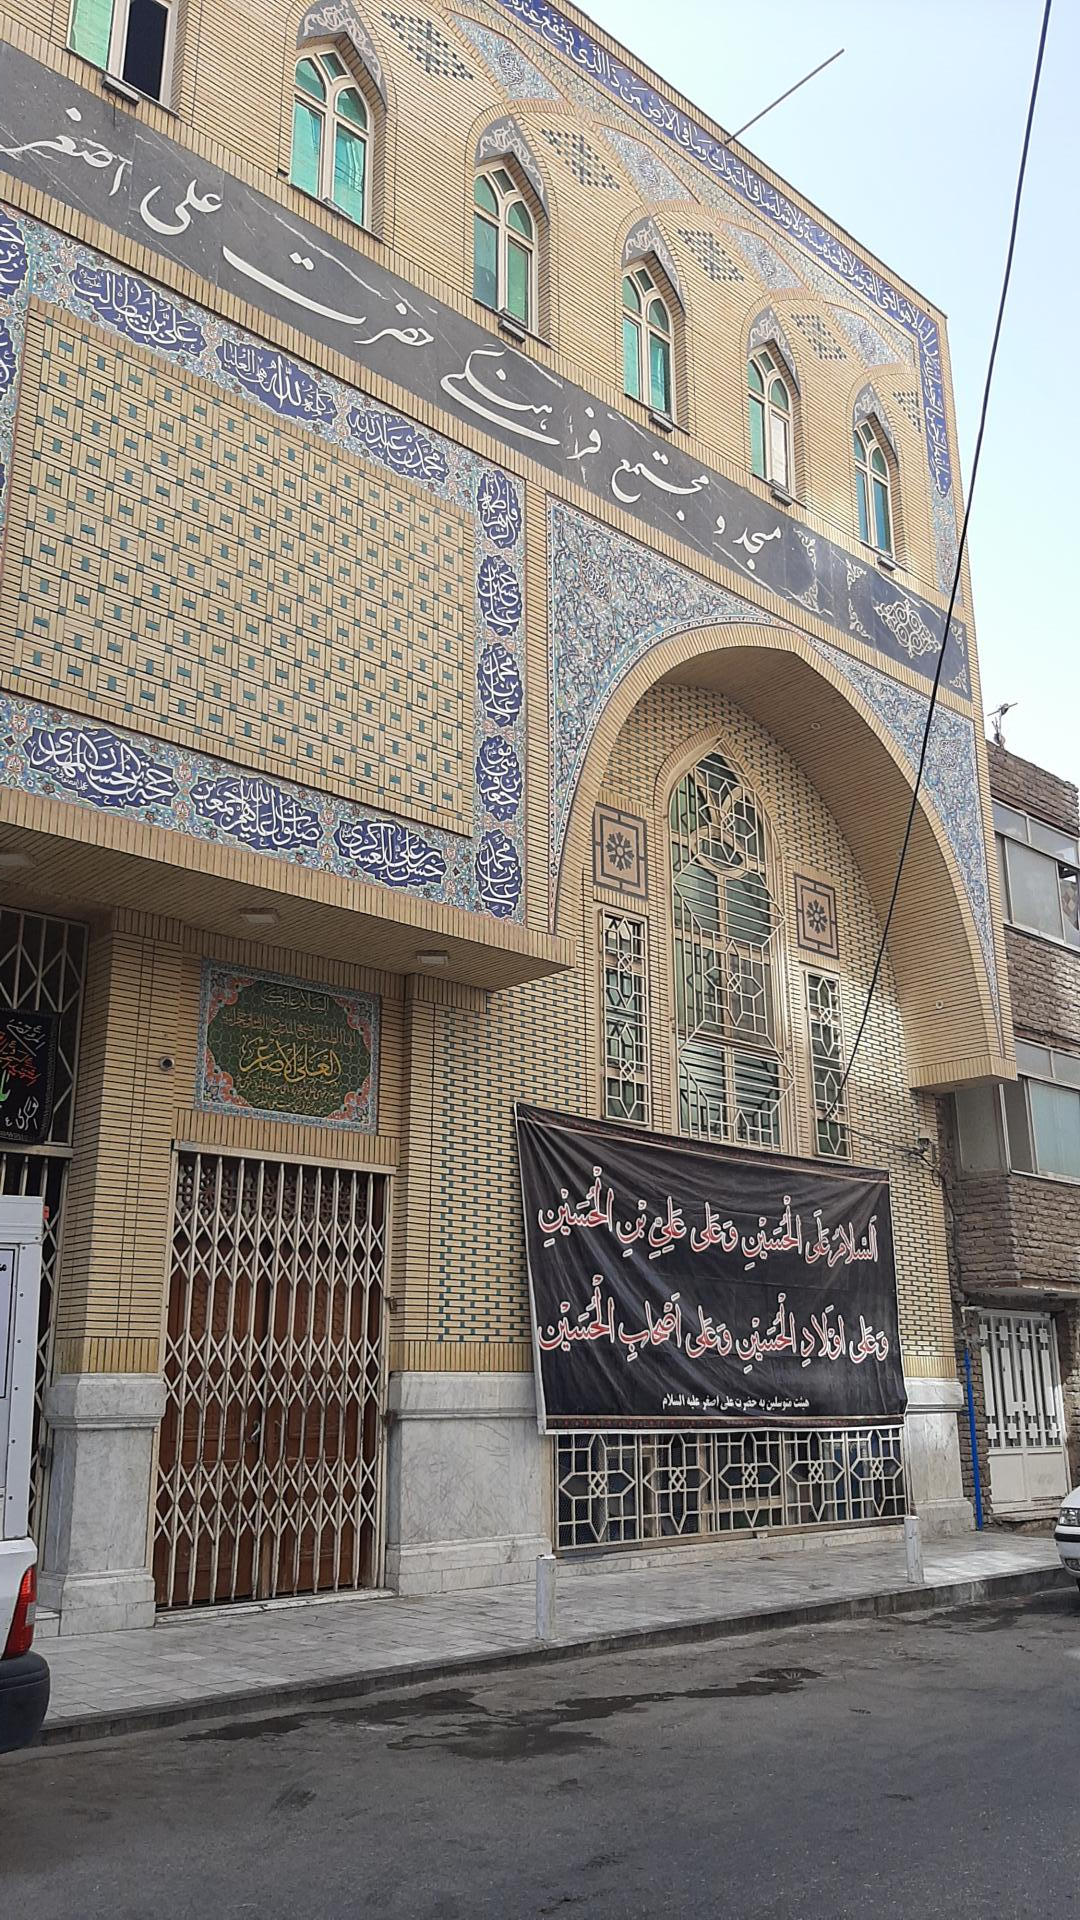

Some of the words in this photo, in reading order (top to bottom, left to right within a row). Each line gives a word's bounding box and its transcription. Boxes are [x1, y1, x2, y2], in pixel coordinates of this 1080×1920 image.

[0, 105, 132, 197] اصغر
[139, 180, 223, 236] علی
[222, 244, 436, 346] حضرت
[610, 448, 711, 522] مجتمع
[713, 515, 725, 536] و
[732, 524, 782, 571] مسجد
